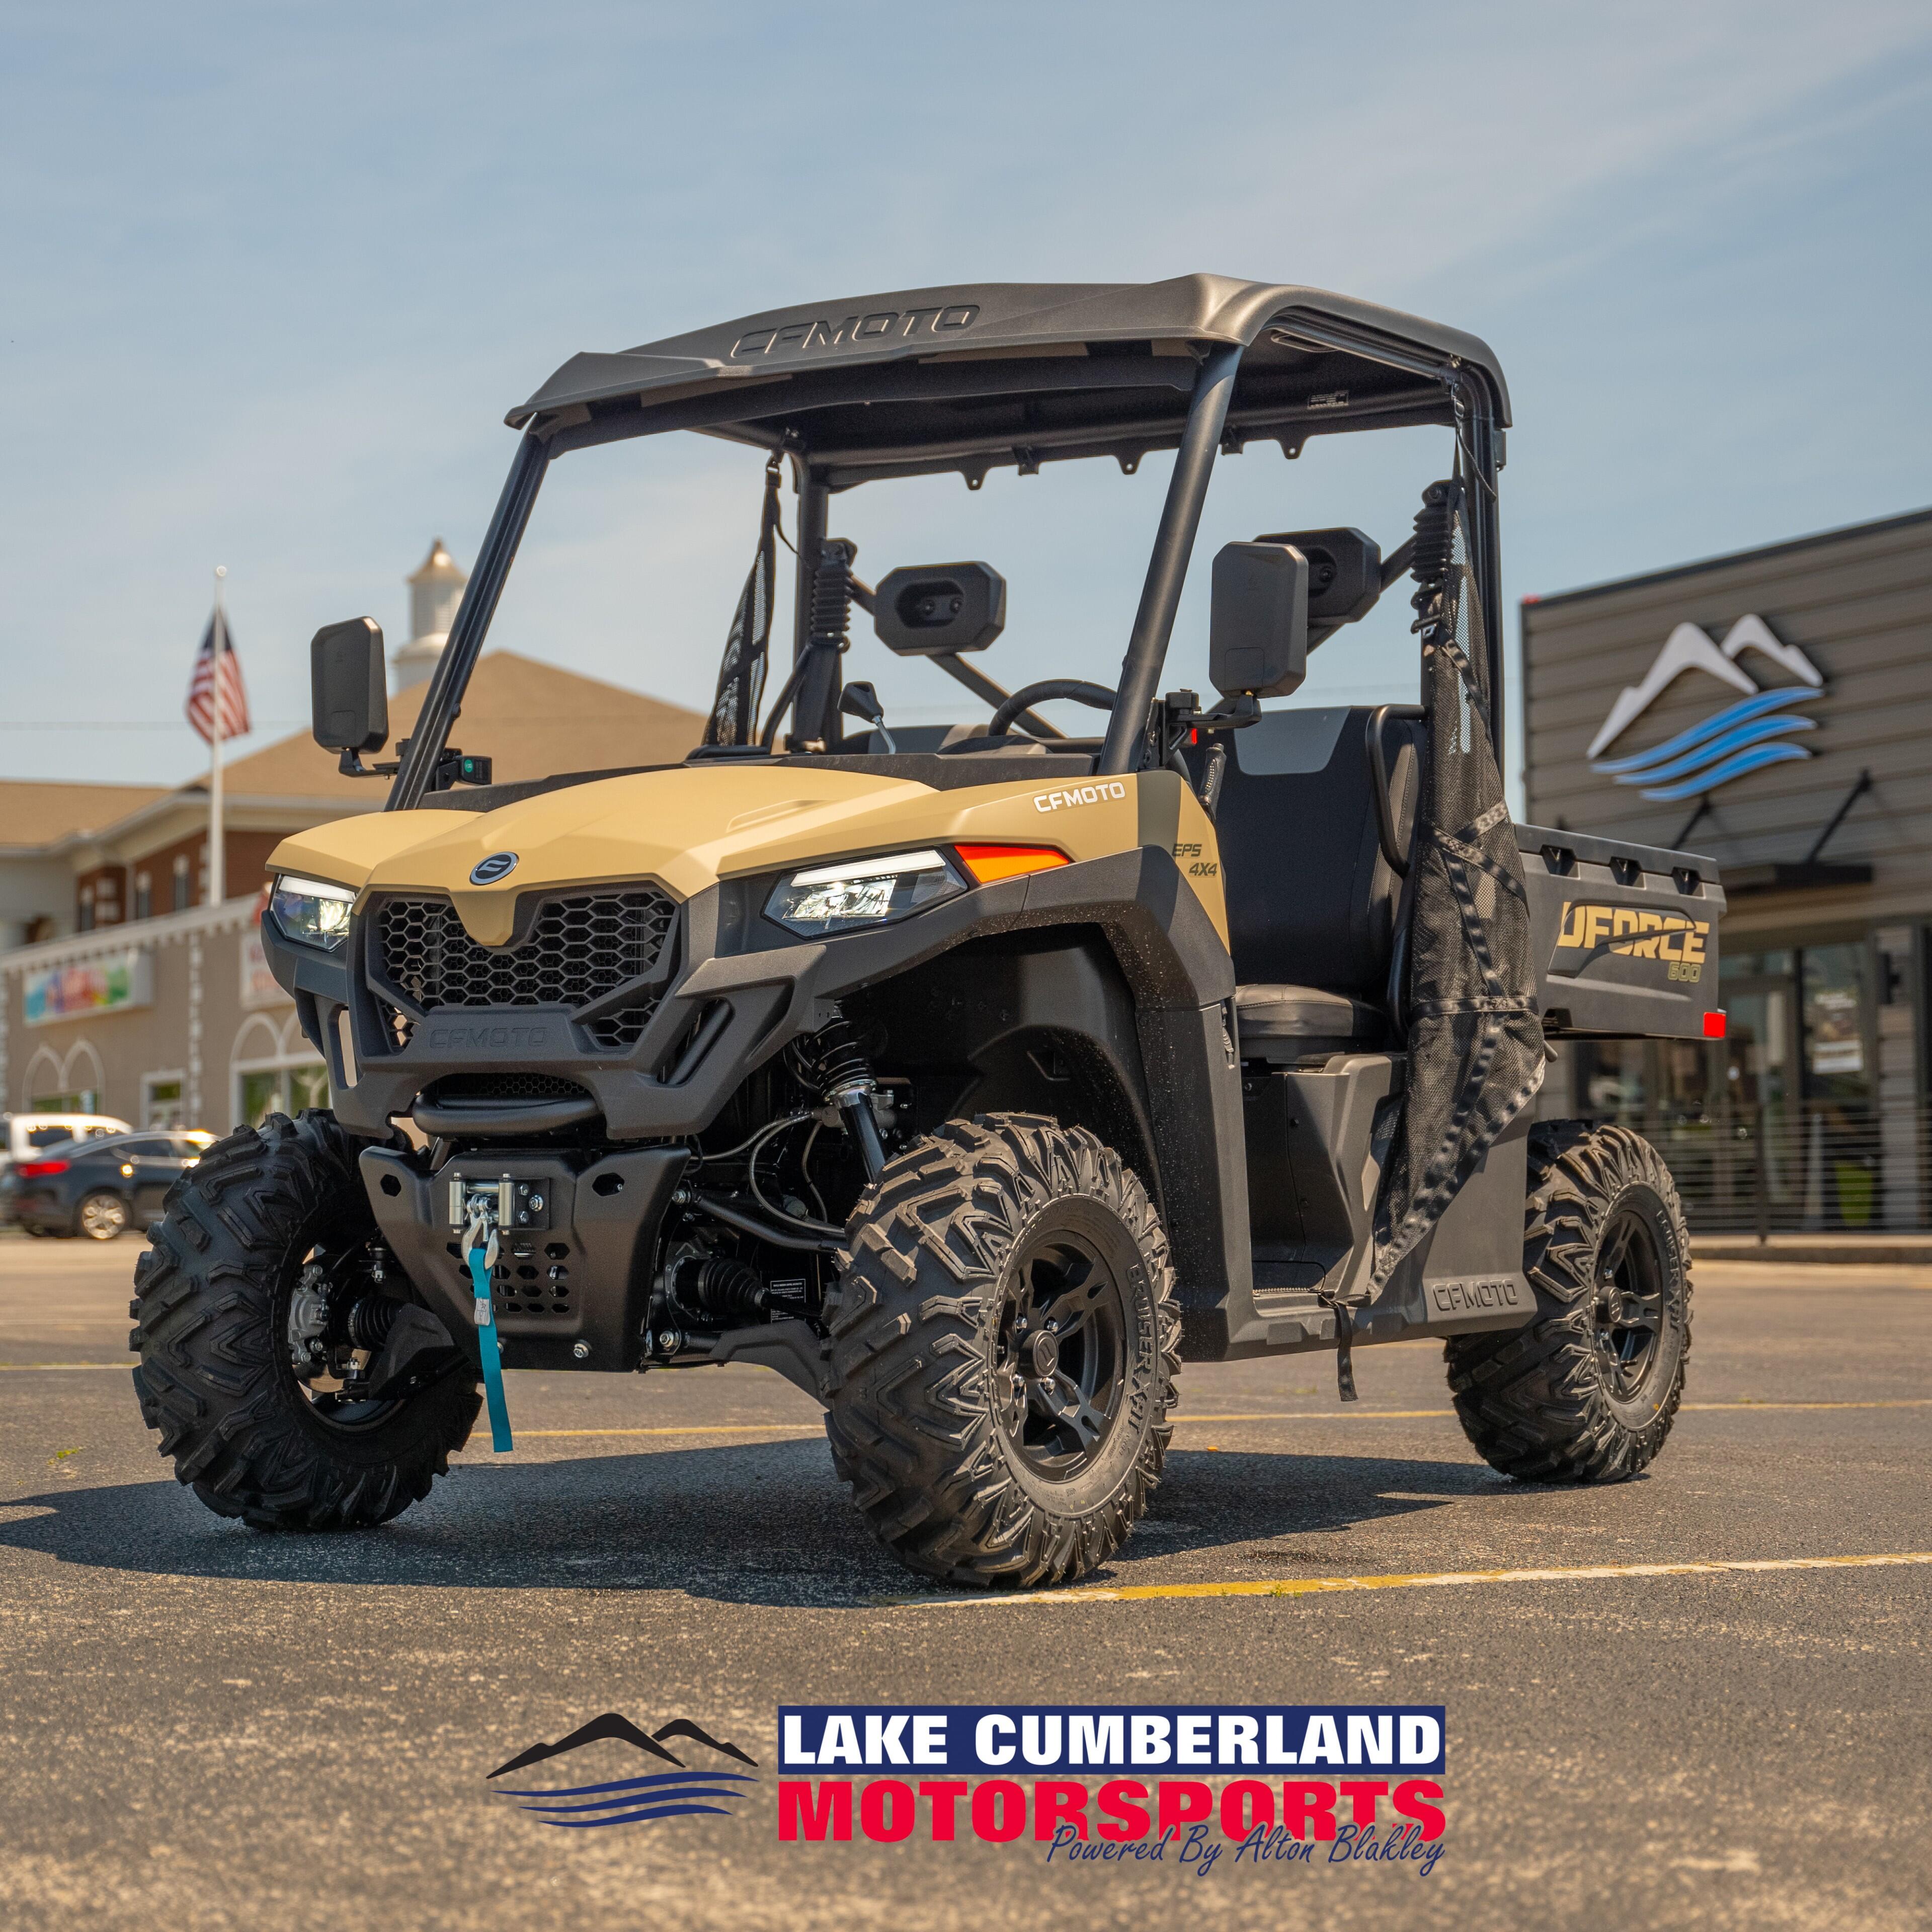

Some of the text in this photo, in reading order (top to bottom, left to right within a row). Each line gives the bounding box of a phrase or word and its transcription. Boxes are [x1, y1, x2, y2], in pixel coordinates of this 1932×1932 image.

[731, 304, 980, 358] CFMOTO
[1034, 782, 1125, 812] CFMOTO
[1172, 844, 1202, 857] EPS
[1189, 862, 1218, 876] 4X4
[1557, 902, 1710, 963] UFORCE
[1667, 961, 1701, 983] 600
[430, 1027, 547, 1048] CFMOTO
[1433, 1279, 1518, 1311] CFMOTO
[1126, 1263, 1153, 1373] BRUISER
